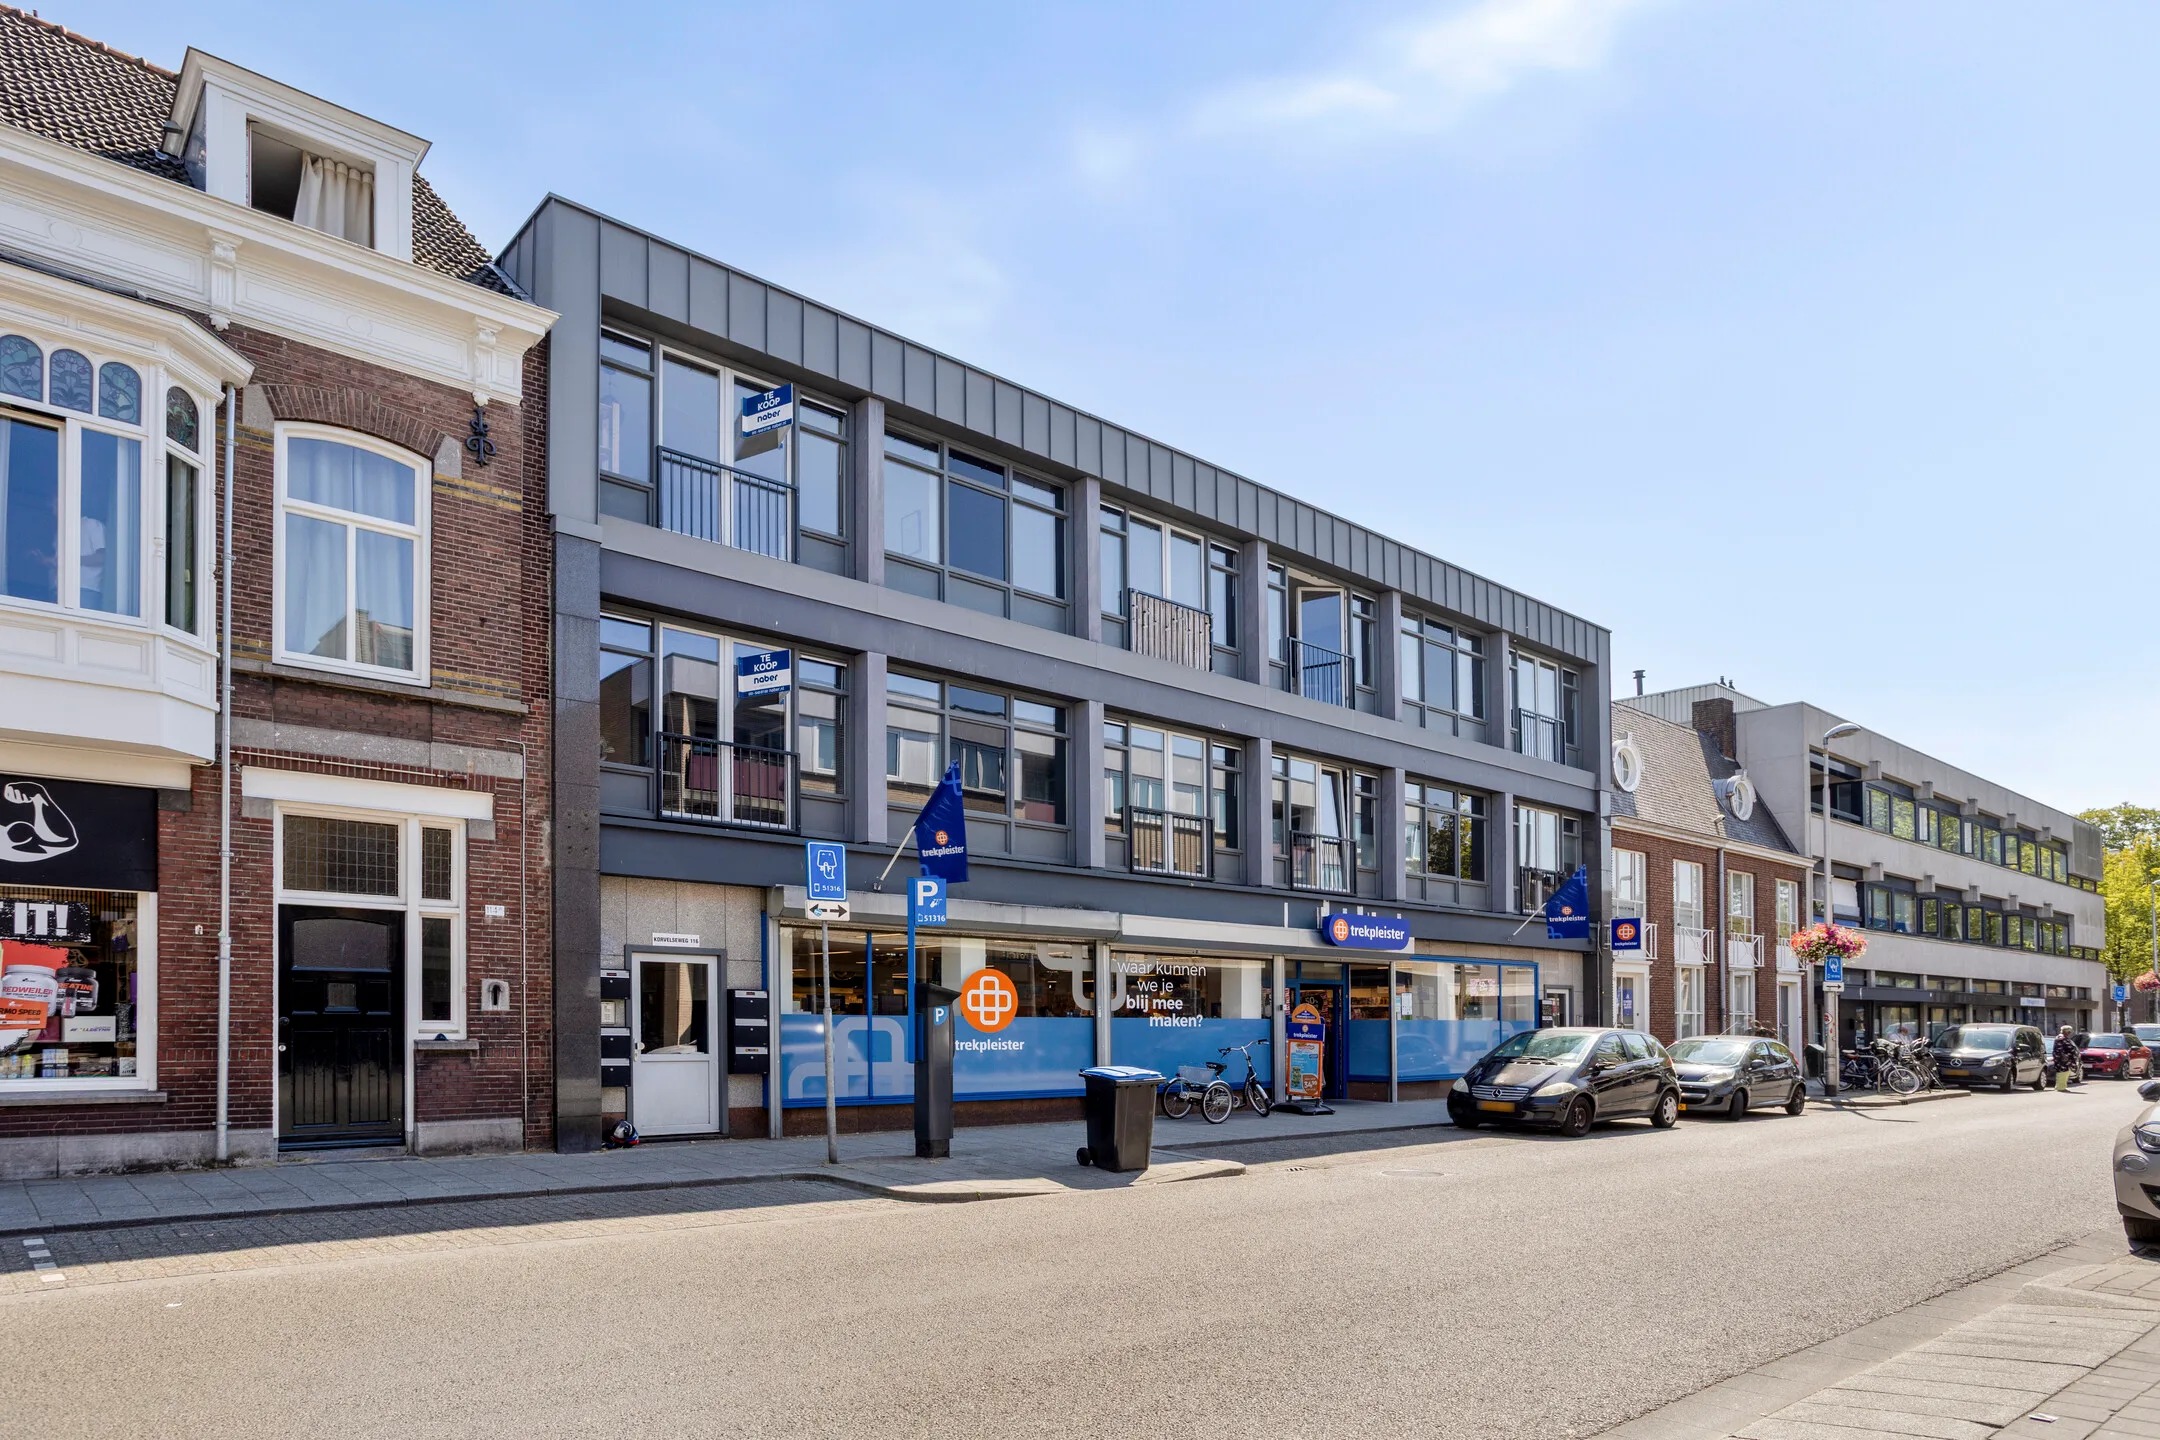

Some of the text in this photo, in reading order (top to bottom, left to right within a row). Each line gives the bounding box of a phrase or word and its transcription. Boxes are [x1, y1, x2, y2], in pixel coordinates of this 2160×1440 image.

[764, 391, 774, 400] TE
[757, 397, 781, 411] KOOP
[757, 409, 781, 423] naber
[760, 653, 771, 662] TE
[753, 661, 778, 672] KOOP
[753, 674, 778, 684] naber
[921, 845, 964, 859] trekpleister
[917, 881, 939, 906] P
[14, 902, 68, 937] IT!
[924, 914, 946, 922] 51316
[1549, 914, 1587, 923] trekpleister
[1350, 925, 1405, 940] trekpleister
[1117, 961, 1207, 976] waar kunnen
[1137, 978, 1174, 995] we je
[1126, 995, 1183, 1012] blij mee
[935, 1008, 945, 1022] P
[1149, 1013, 1203, 1027] maken?
[955, 1038, 1025, 1053] trekpleister
